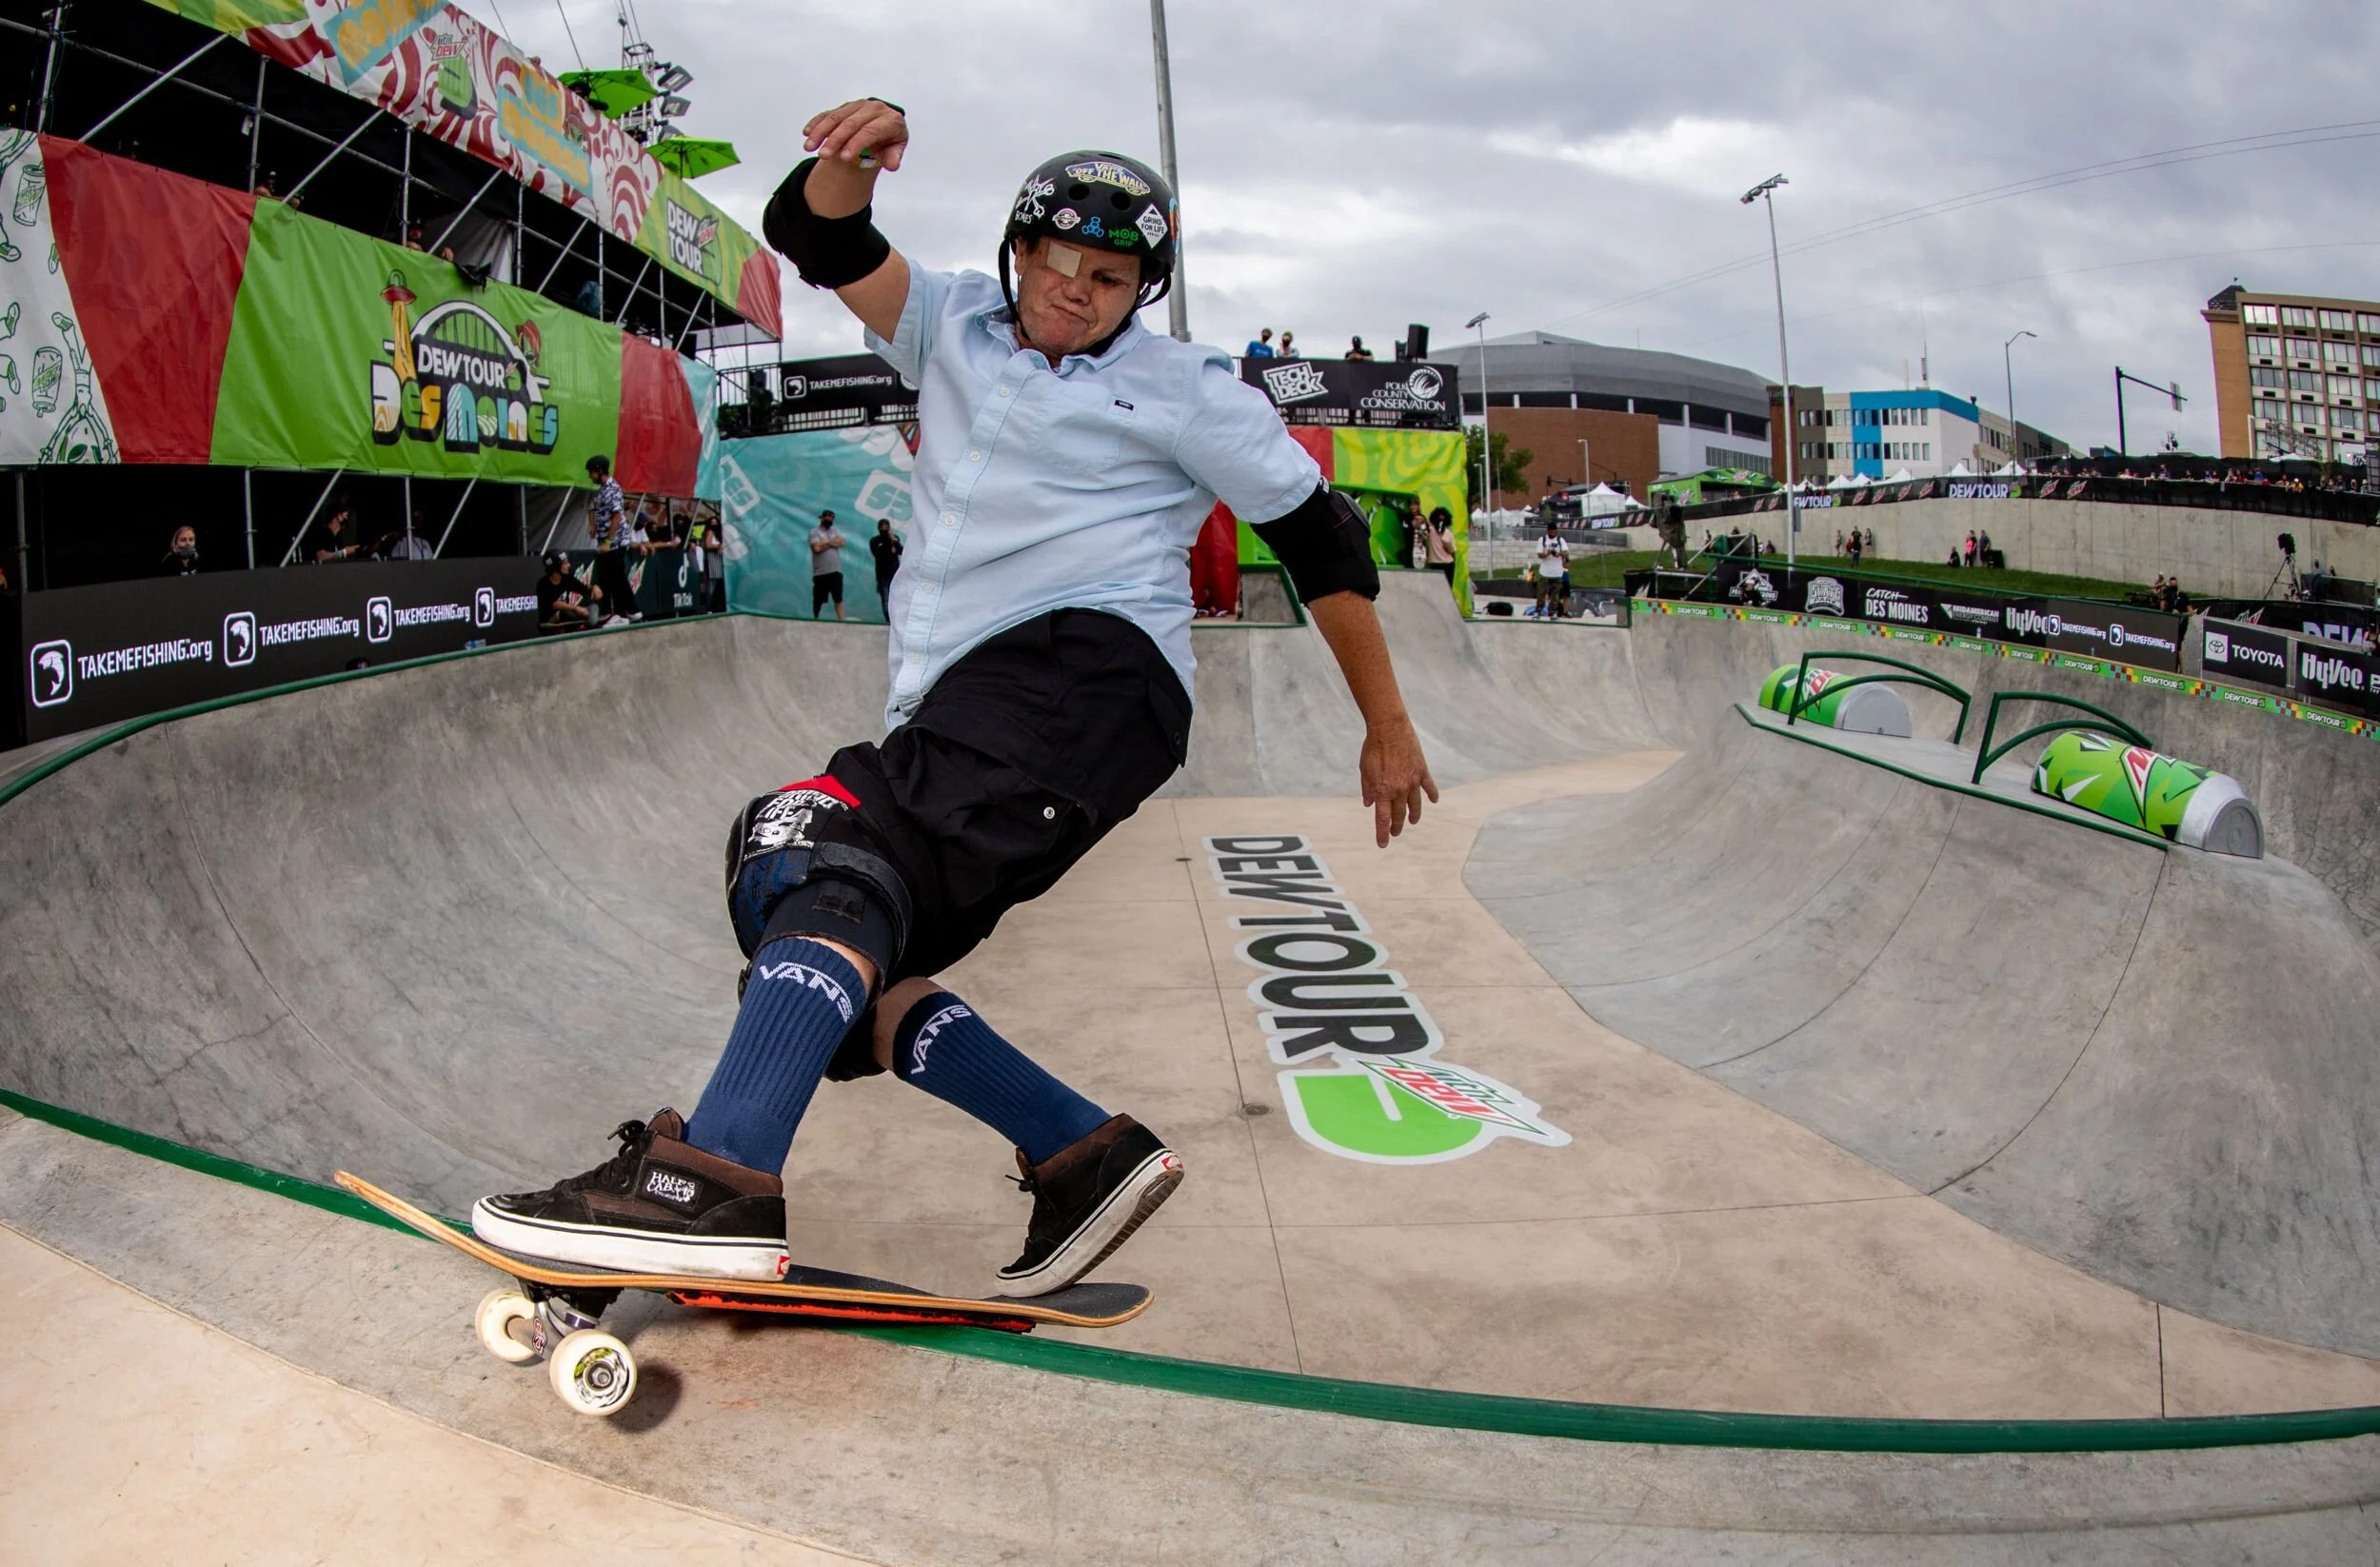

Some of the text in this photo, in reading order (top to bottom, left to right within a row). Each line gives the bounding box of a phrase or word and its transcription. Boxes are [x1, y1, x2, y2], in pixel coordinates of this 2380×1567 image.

[1097, 169, 1118, 182] THE
[667, 199, 699, 242] DEW
[1015, 210, 1033, 224] BONES
[1142, 215, 1162, 226] GRIND
[1108, 228, 1139, 241] MOB
[1141, 223, 1165, 234] FOR LIFE
[1114, 238, 1134, 247] GRIP
[668, 229, 704, 275] TOUR
[1269, 366, 1309, 384] TECH
[1276, 378, 1319, 399] DECK
[1373, 388, 1409, 398] COUNTY
[371, 364, 442, 433] DES
[1360, 397, 1446, 411] CONSERVATION
[446, 383, 559, 446] MOINES
[672, 591, 693, 607] TikTok
[1866, 587, 1909, 600] CATCH
[1865, 598, 1886, 618] DES
[1888, 602, 1929, 624] MOINES
[2231, 644, 2285, 668] TOYOTA
[759, 962, 854, 1023] VANS
[910, 1004, 973, 1074] VANS
[650, 1171, 686, 1186] HALF
[647, 1180, 675, 1193] CAB
